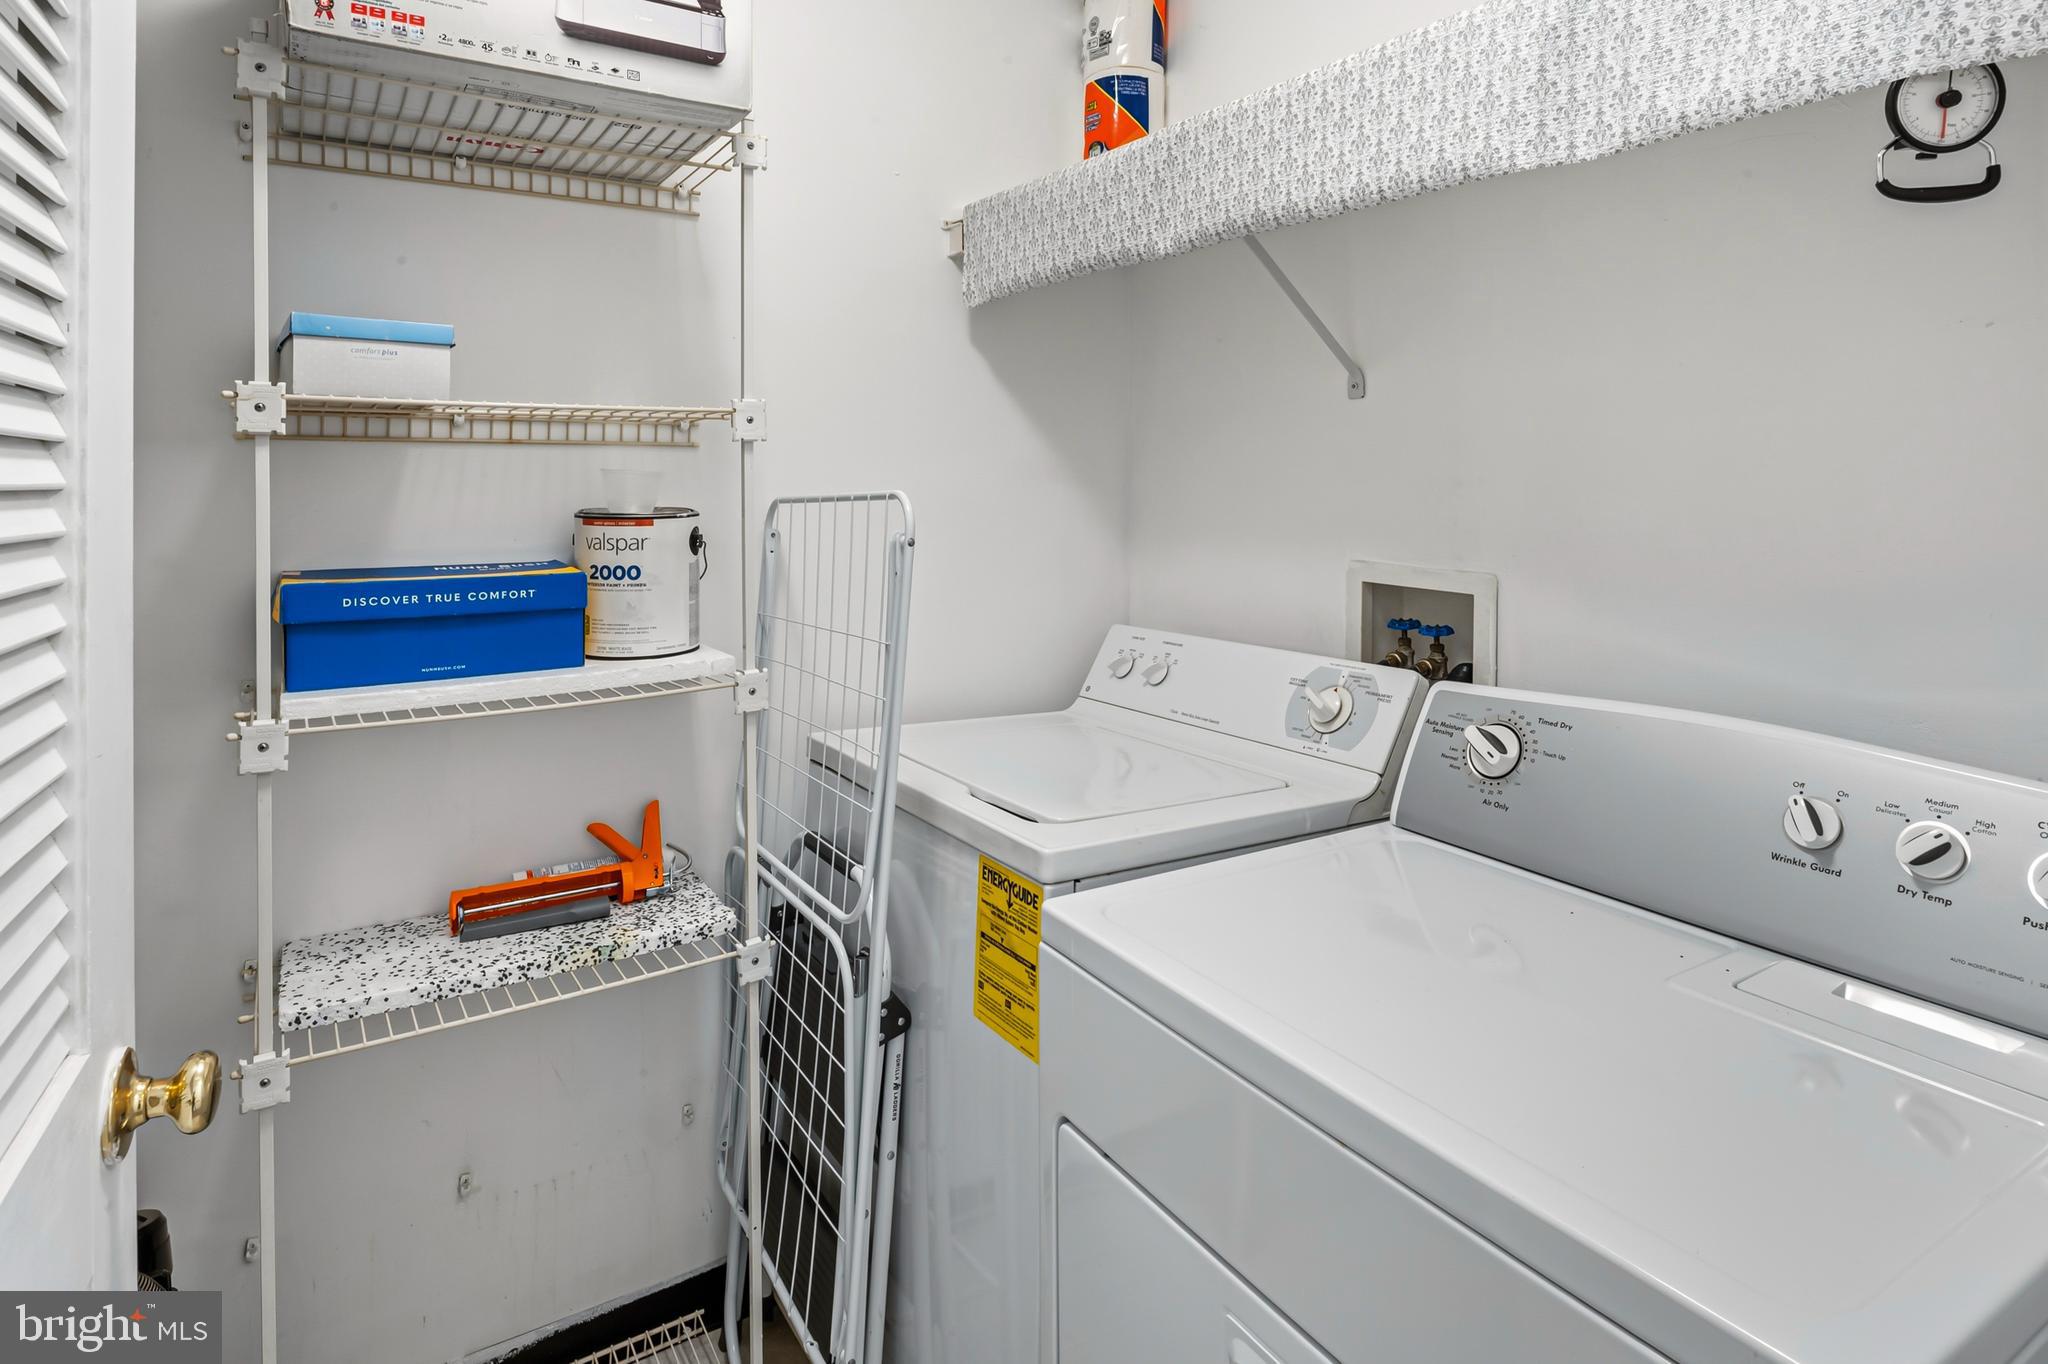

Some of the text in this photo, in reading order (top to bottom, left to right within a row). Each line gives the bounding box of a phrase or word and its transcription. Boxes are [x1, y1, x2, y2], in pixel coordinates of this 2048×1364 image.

[482, 43, 493, 52] 45
[586, 532, 648, 556] valspar
[590, 564, 642, 581] 2000
[343, 589, 536, 608] DISCOVER TRUE COMFORT
[1425, 718, 1464, 731] Auto Moisture
[1538, 717, 1573, 731] Timed Dry
[1432, 726, 1454, 738] Sensing
[1441, 753, 1458, 761] Normal
[1543, 750, 1557, 758] Touch
[1793, 781, 1805, 789] Off
[1837, 790, 1849, 798] On
[1493, 801, 1509, 812] Only
[1884, 801, 1900, 809] Low
[1925, 798, 1959, 810] Medium
[1875, 806, 1907, 818] Delicates
[1928, 805, 1953, 815] Casual
[1975, 819, 1996, 829] High
[2038, 821, 2048, 830] C
[1972, 826, 1997, 836] Cotton
[1771, 851, 1842, 878] Wrinkle Guard
[1897, 884, 1953, 907] Dry Temp
[1950, 956, 1966, 966] AUTO
[1967, 961, 1997, 975] MOISTURE
[1998, 969, 2024, 983] SENSING
